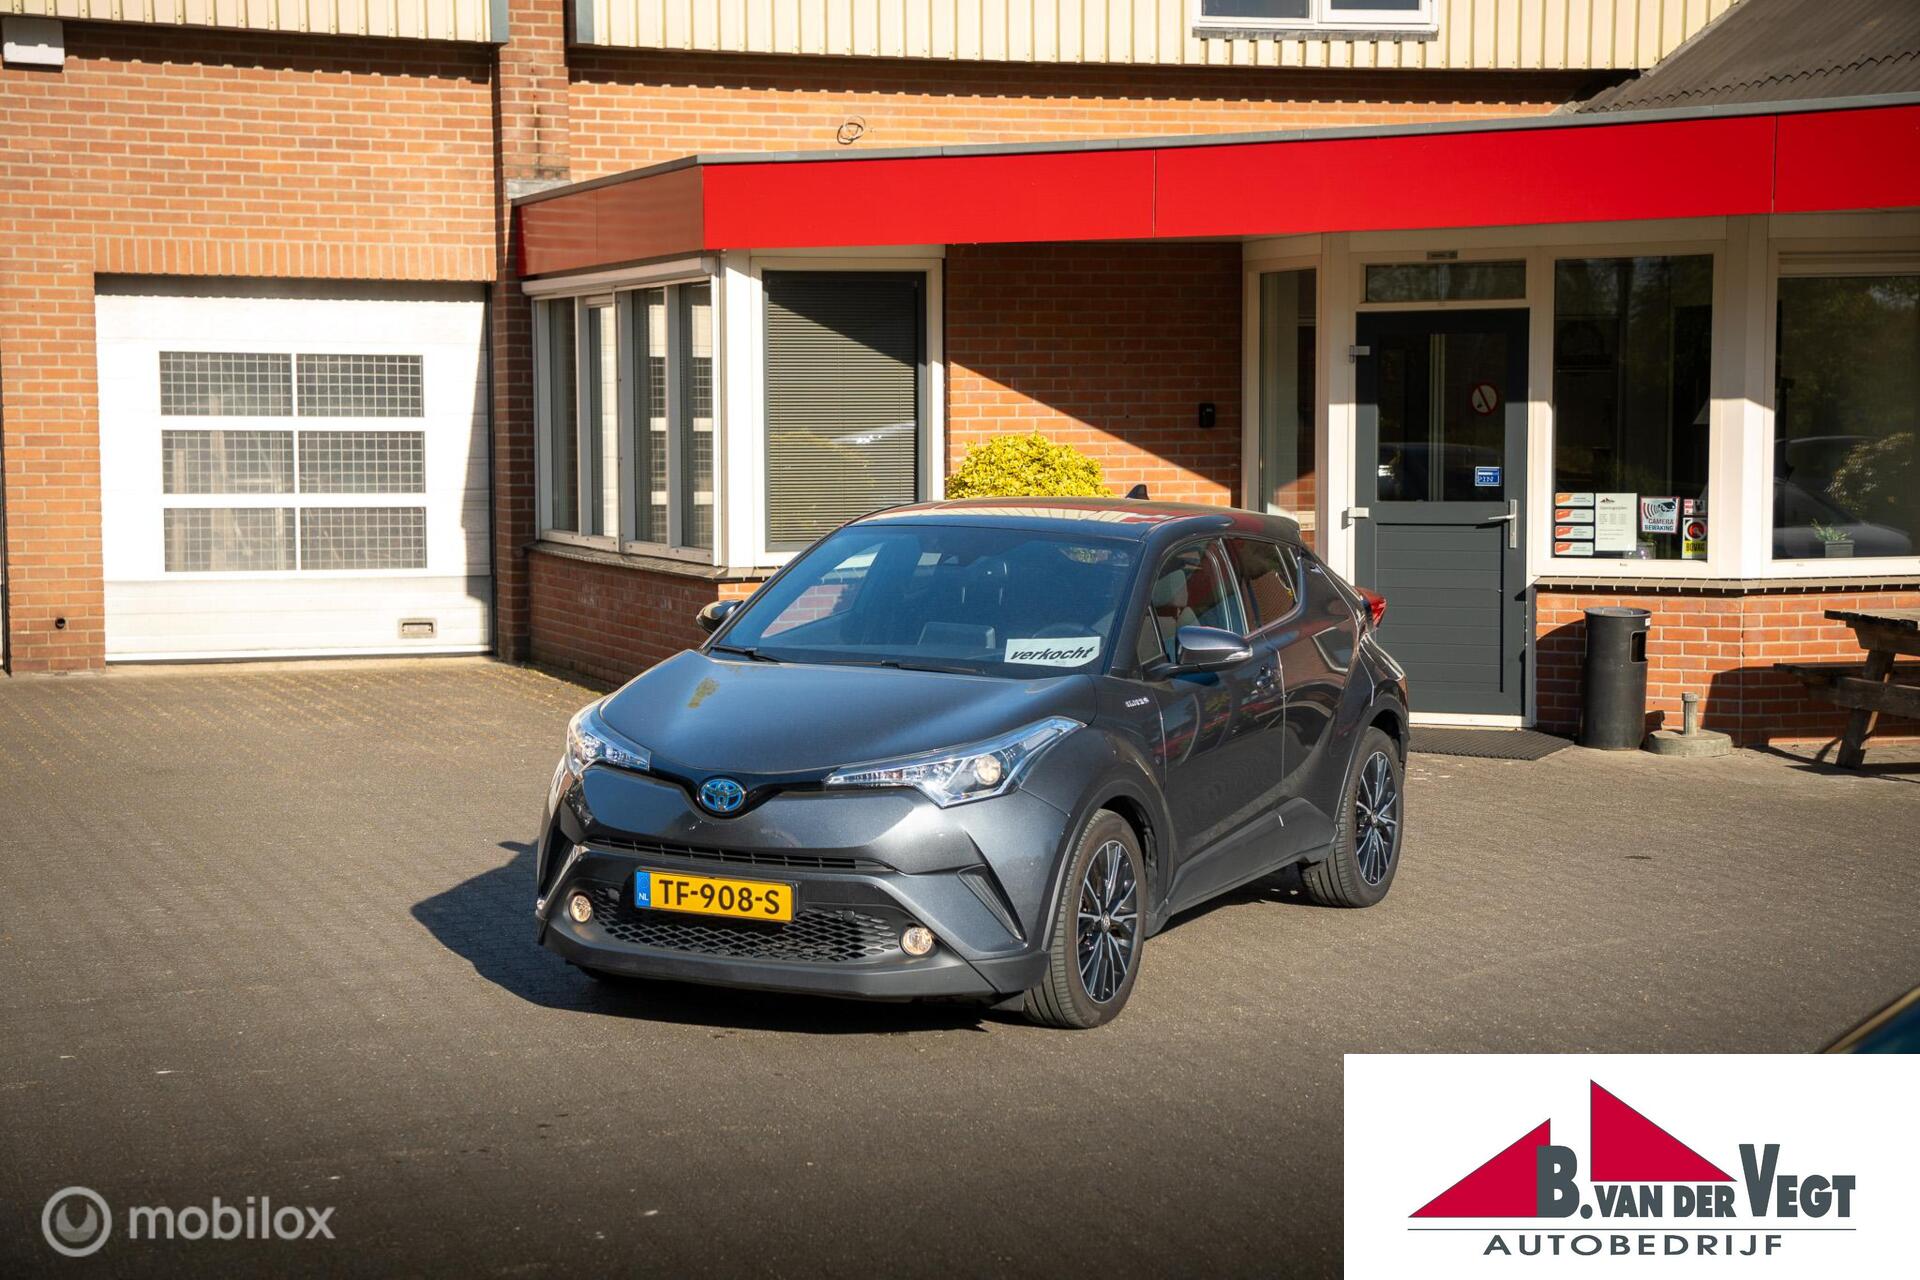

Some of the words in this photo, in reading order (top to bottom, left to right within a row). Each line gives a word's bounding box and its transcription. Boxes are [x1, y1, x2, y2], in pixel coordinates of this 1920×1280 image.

[1010, 646, 1096, 660] verkocht
[638, 893, 649, 901] NL
[658, 879, 780, 915] TF-908-S
